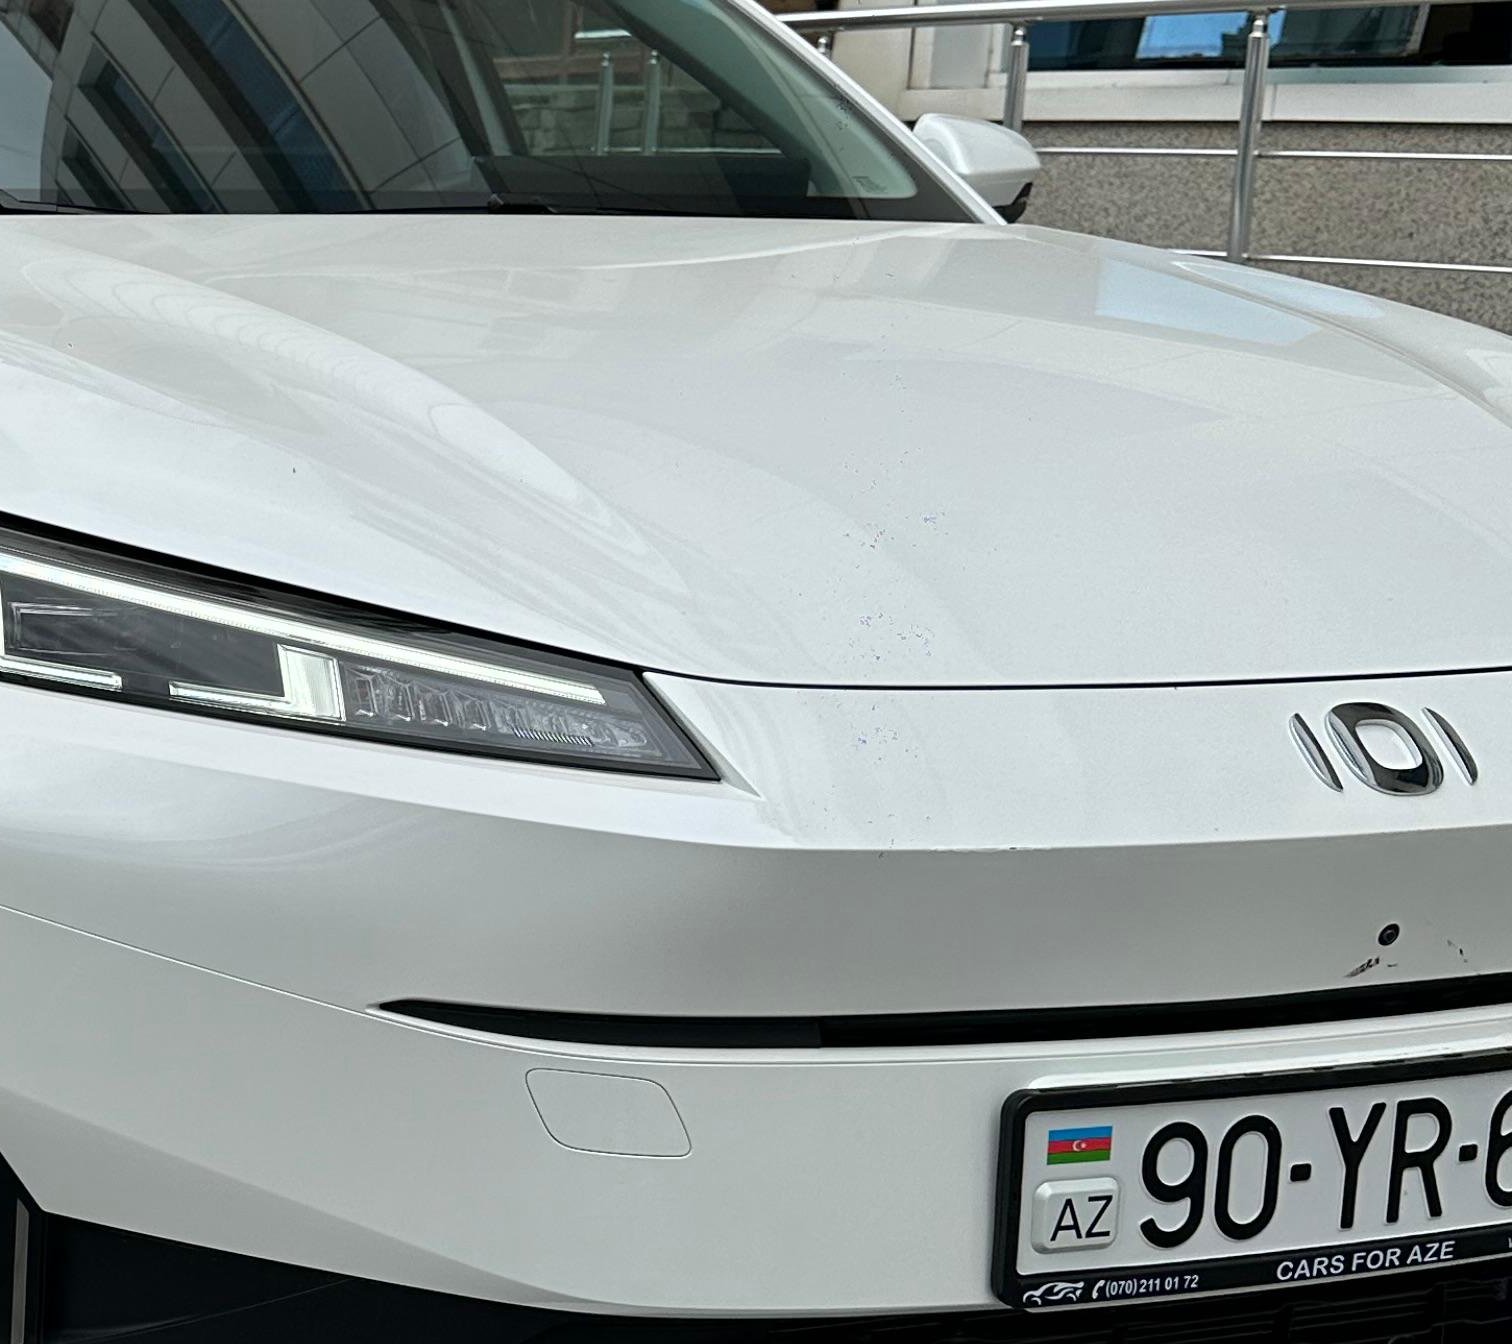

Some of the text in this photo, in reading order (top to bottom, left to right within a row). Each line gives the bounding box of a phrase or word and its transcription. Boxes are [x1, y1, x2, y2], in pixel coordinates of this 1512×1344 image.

[1049, 1194, 1115, 1243] AZ
[1276, 1240, 1456, 1281] CARS FOR AZE
[1105, 1274, 1200, 1298] (070) 211 01 72
